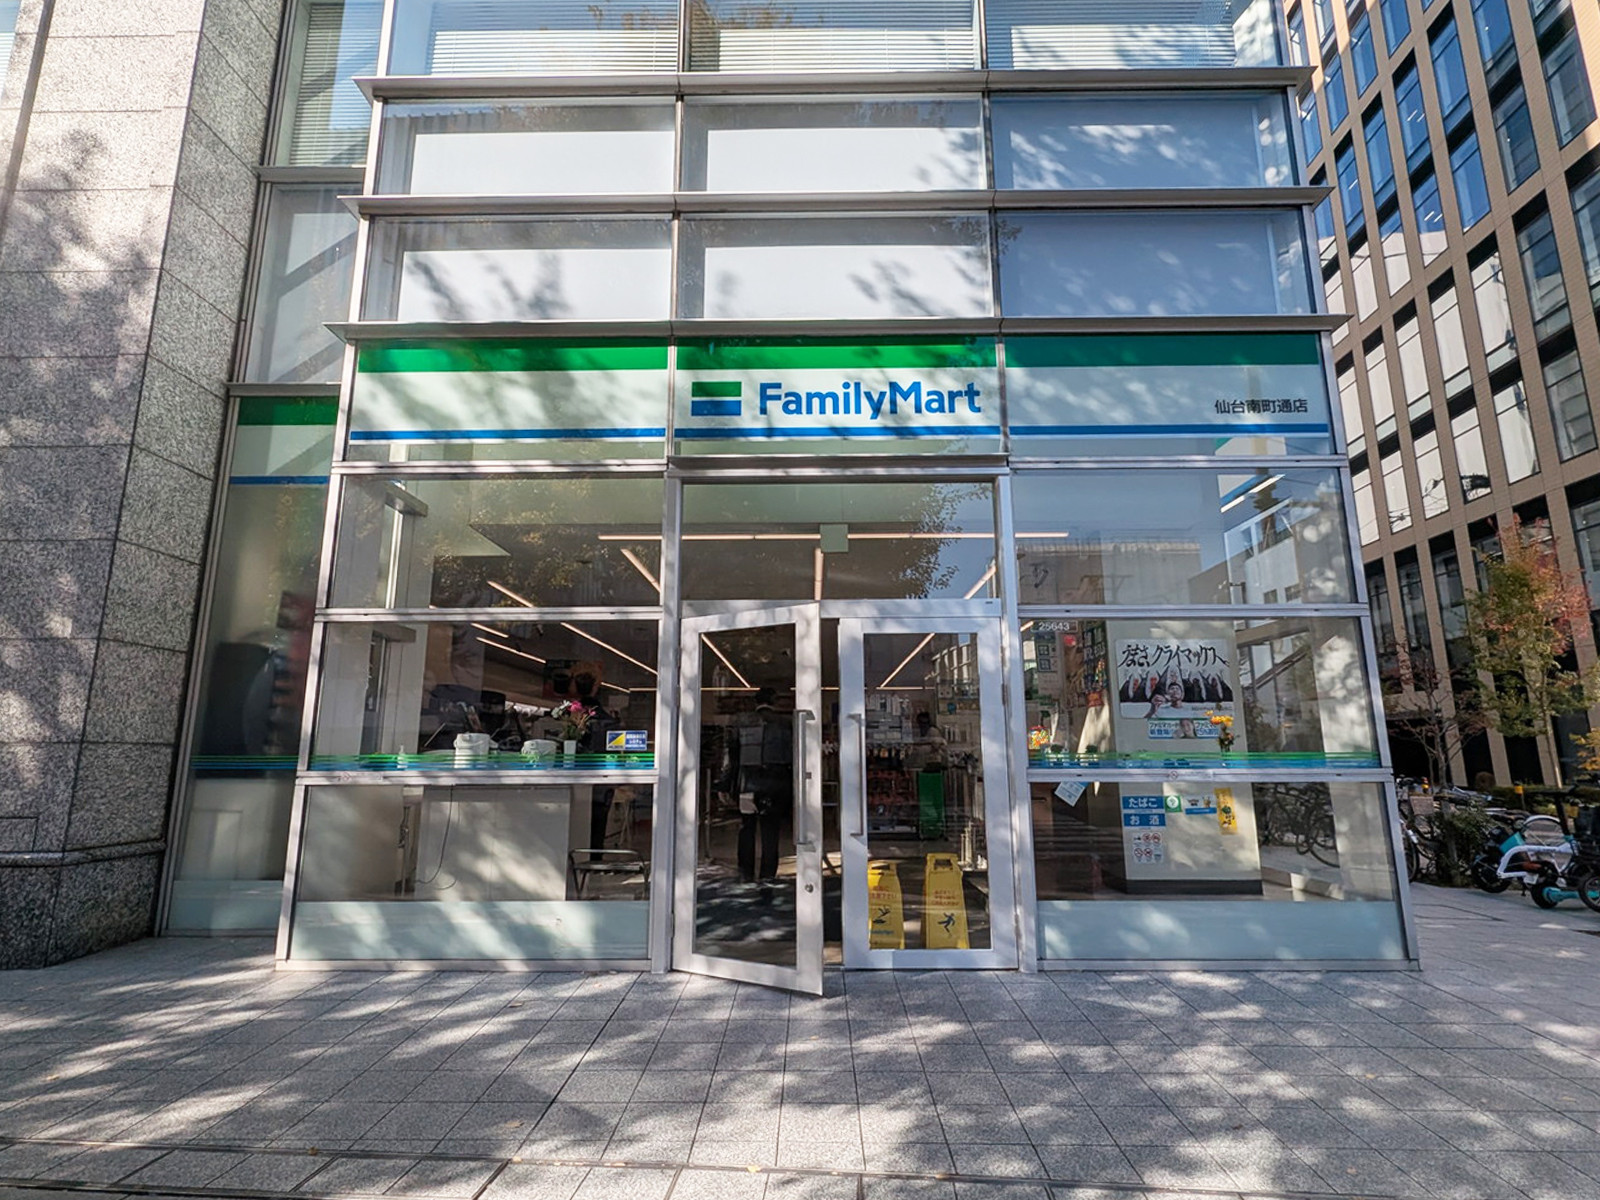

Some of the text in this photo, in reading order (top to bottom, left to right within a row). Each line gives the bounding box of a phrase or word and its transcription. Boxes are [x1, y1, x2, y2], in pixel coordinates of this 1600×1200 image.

[759, 381, 982, 420] FamilyMart
[1214, 399, 1308, 414] 仙台南町通店
[1128, 797, 1158, 808] たばこ
[1130, 815, 1160, 826] お酒
